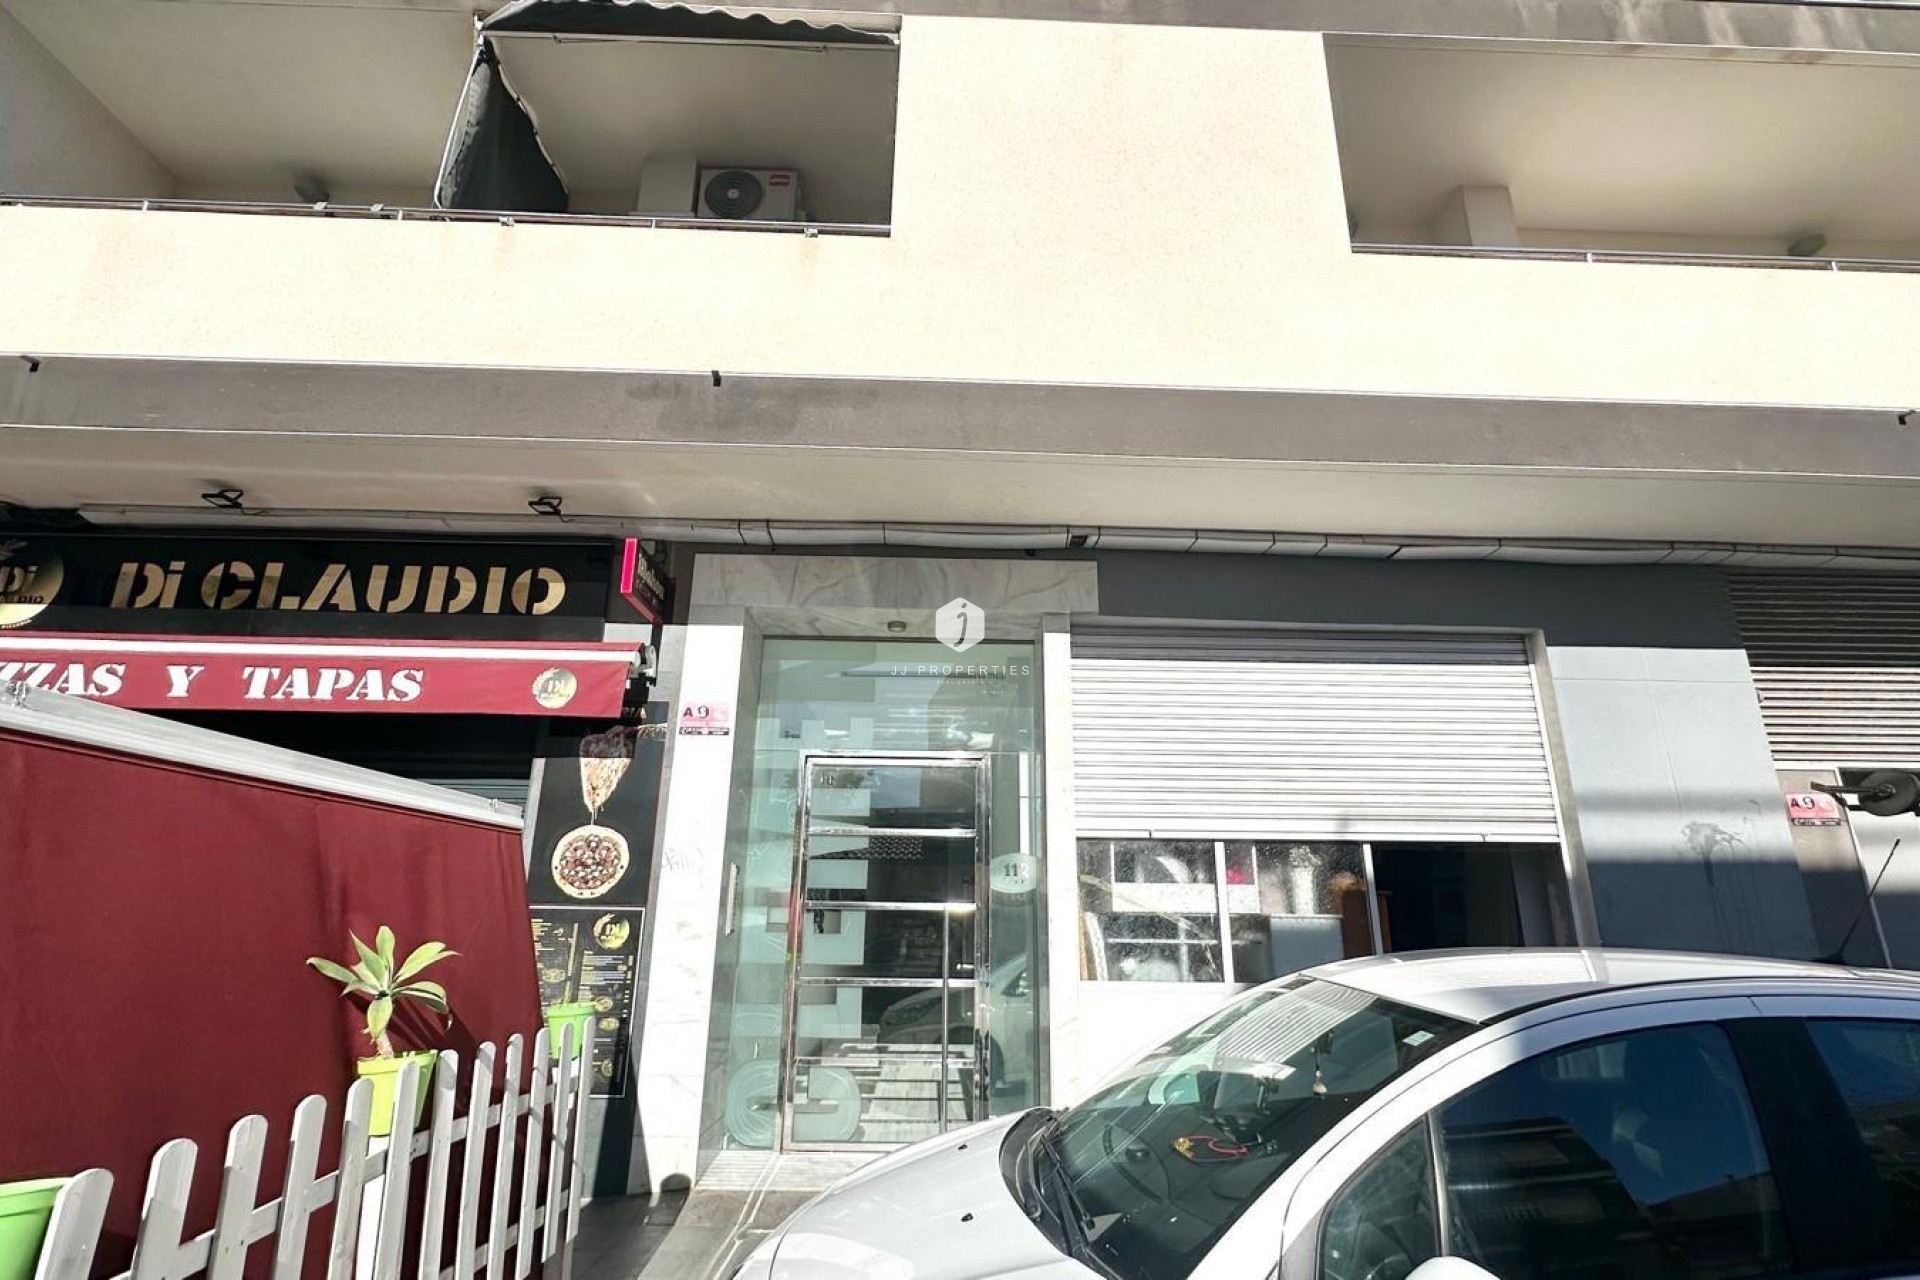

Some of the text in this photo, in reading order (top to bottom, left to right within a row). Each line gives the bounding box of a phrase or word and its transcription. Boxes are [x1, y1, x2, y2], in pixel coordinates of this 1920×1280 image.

[111, 561, 566, 615] Di CLAUDIO
[166, 664, 204, 698] Y
[242, 666, 424, 701] TAPAS
